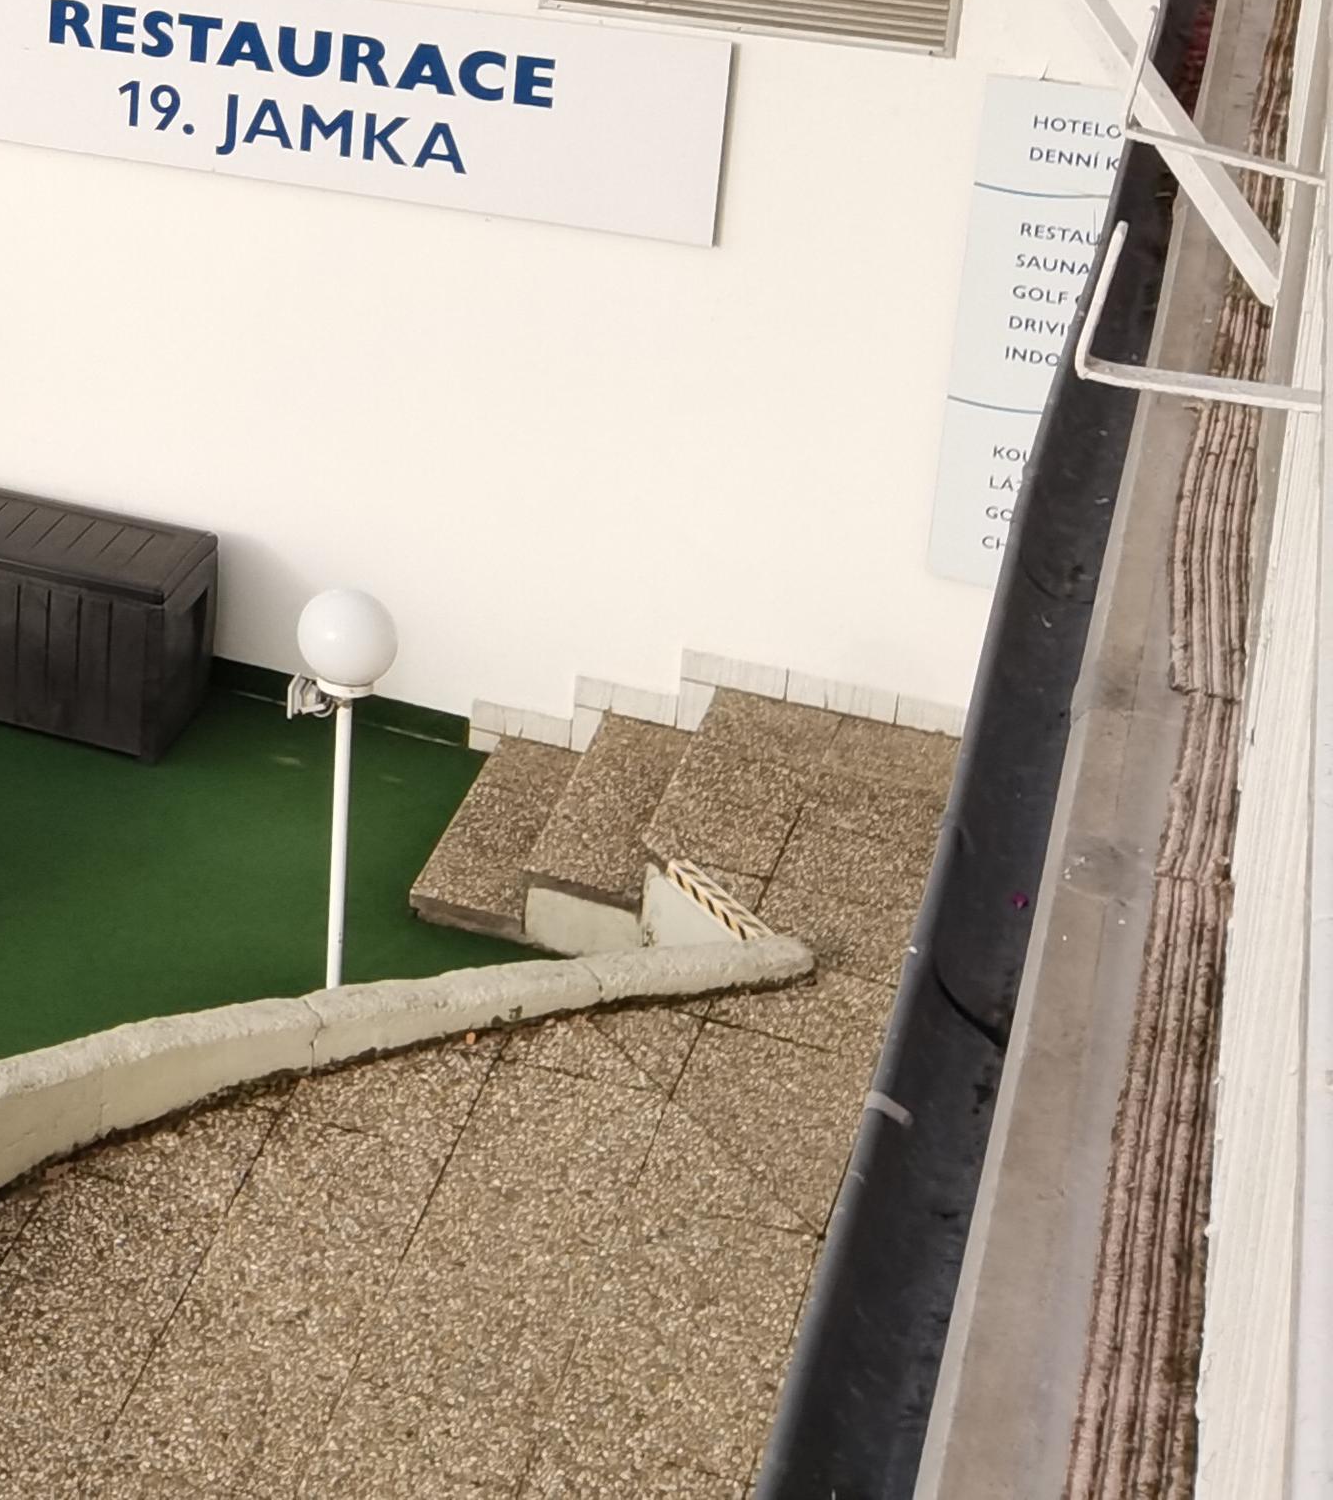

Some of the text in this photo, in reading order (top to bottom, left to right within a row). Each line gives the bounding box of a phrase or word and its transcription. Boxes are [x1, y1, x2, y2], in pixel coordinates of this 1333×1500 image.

[117, 81, 467, 176] 19. JAMKA
[1029, 146, 1100, 170] DENNÍ
[1015, 253, 1091, 276] SAUNA
[1012, 284, 1069, 305] GOLF
[1004, 345, 1060, 367] INDO
[988, 473, 1021, 493] LÁ
